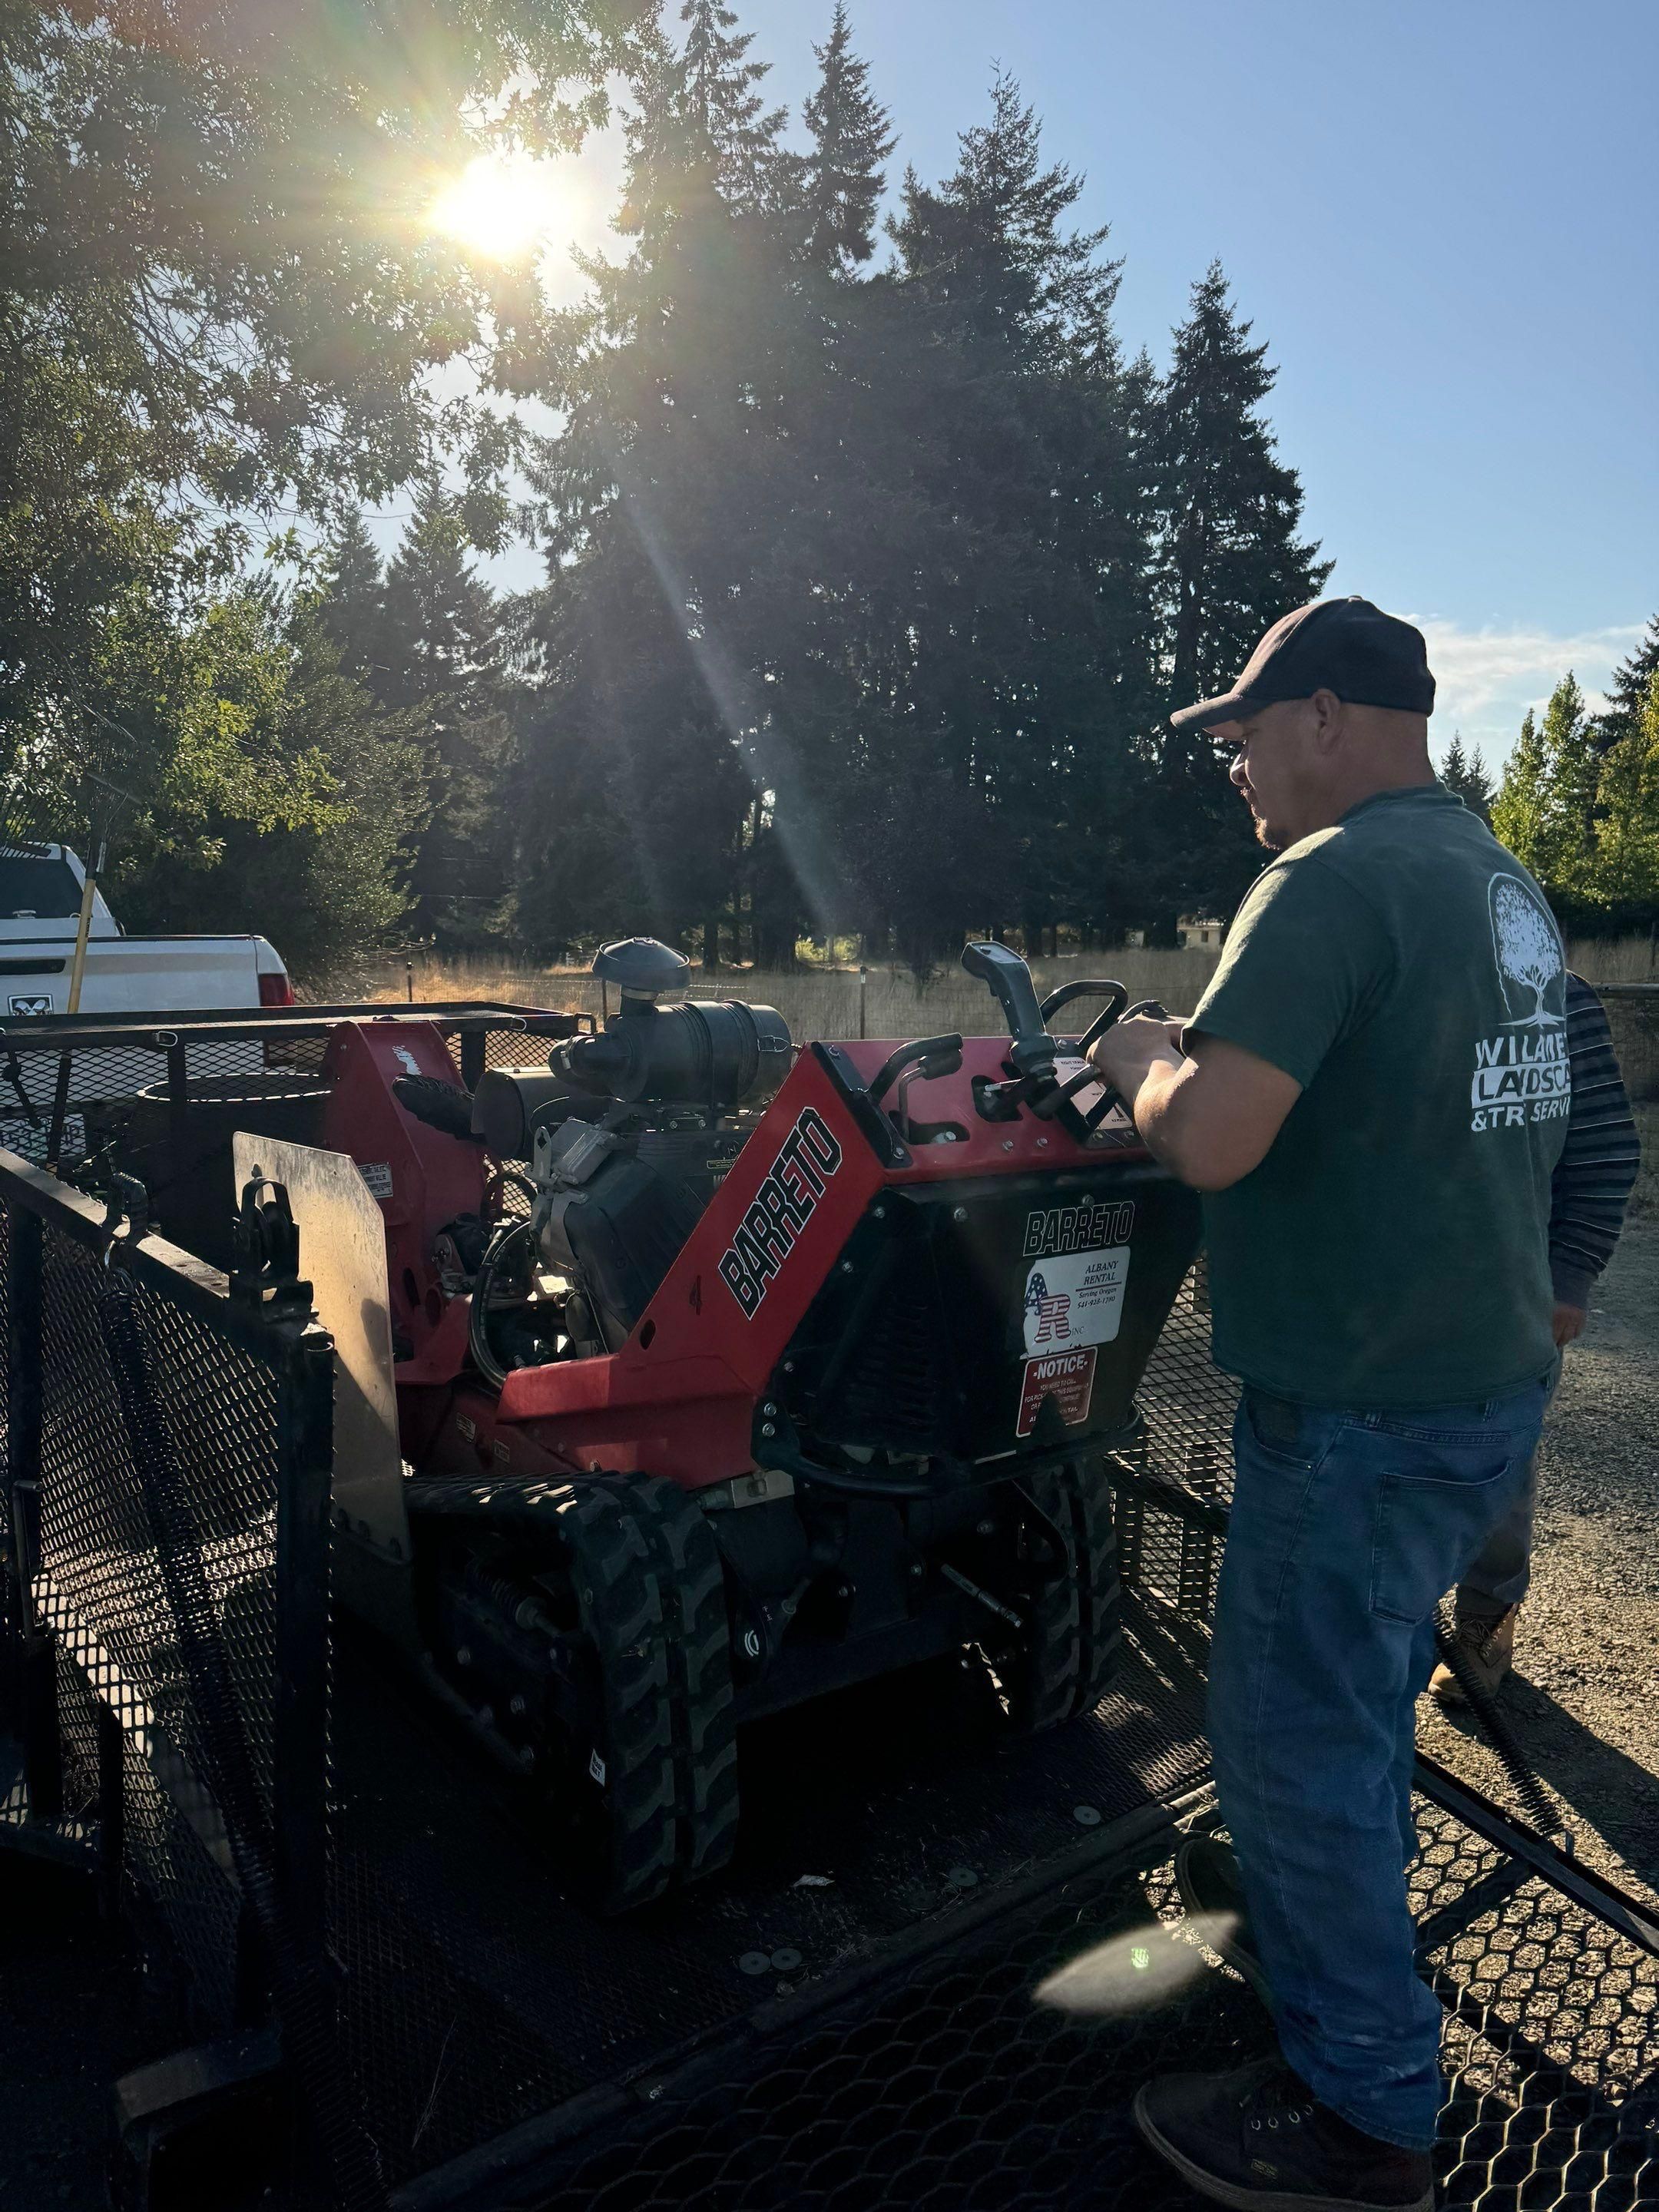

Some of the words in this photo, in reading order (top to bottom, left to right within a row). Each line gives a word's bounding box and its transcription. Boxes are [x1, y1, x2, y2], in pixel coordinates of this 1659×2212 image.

[718, 1107, 843, 1320] BARRETO
[1023, 1201, 1135, 1257] BARRETO
[1085, 1260, 1119, 1274] ALBANY
[1084, 1272, 1115, 1285] RENTAL
[1078, 1290, 1098, 1299] Serving
[1099, 1287, 1118, 1296] Oregon
